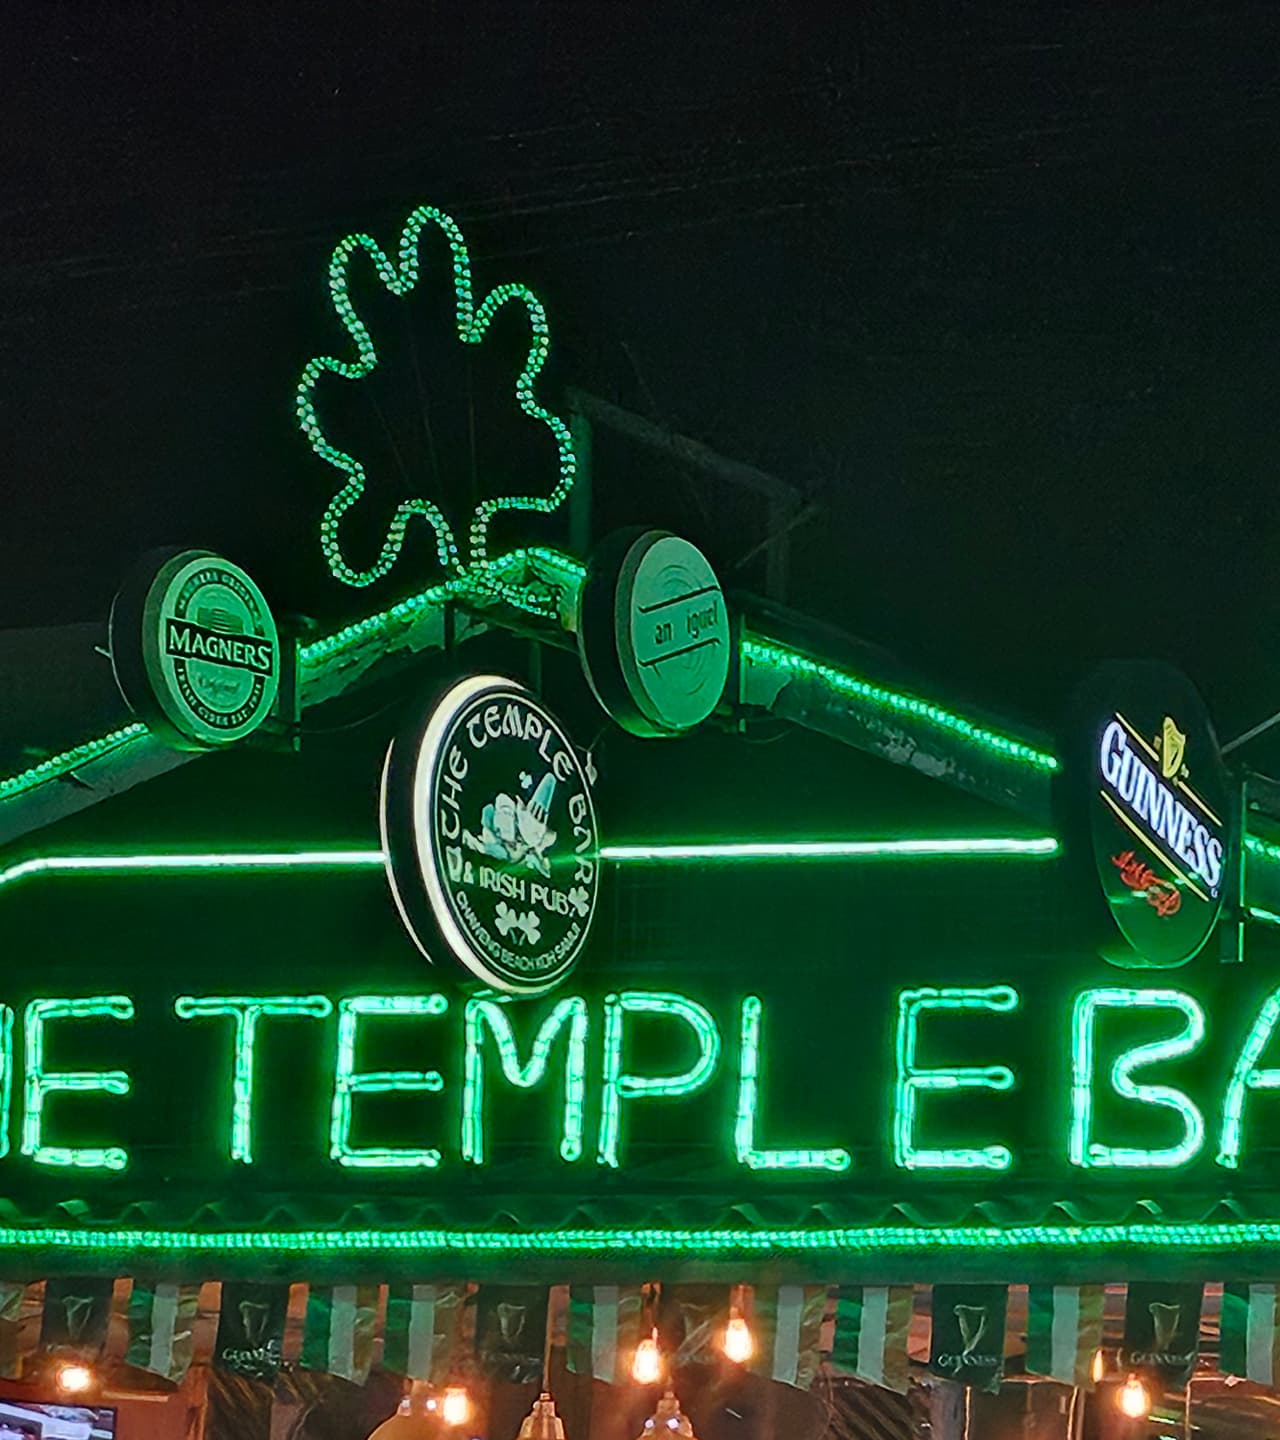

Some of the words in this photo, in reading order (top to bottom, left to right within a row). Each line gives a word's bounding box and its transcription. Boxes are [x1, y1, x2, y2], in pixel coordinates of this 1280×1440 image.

[168, 624, 272, 670] MAGNERS
[466, 703, 574, 782] TEMPLE
[568, 793, 594, 885] BAR
[1100, 720, 1223, 888] GUINNESS
[480, 865, 525, 901] IRISH
[530, 883, 570, 916] PUB
[0, 995, 135, 1171] E
[175, 990, 1018, 1171] TEMPLE
